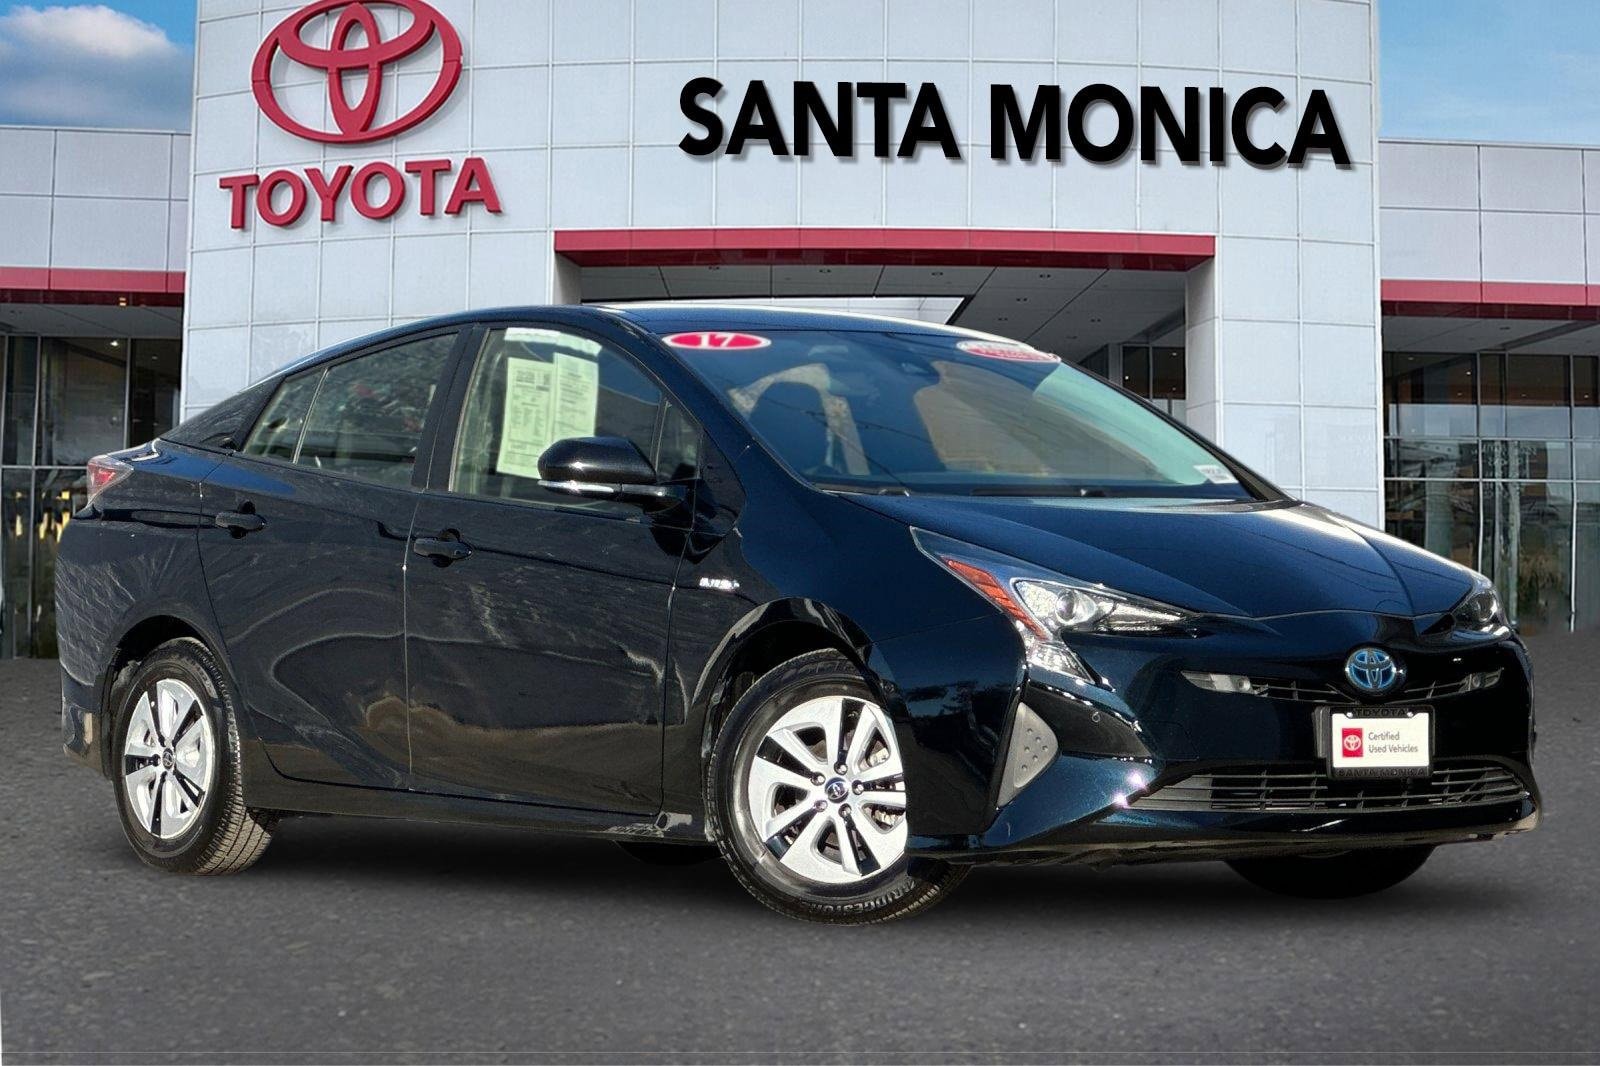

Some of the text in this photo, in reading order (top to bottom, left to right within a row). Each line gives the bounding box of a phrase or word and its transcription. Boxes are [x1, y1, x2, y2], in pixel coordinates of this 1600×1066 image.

[678, 76, 1351, 166] SANTA MONICA
[219, 157, 502, 229] TOYOTA
[697, 333, 736, 348] 17
[1355, 708, 1407, 718] TOYOTA
[1368, 731, 1400, 741] Certified
[1368, 744, 1418, 753] Used Vehicles
